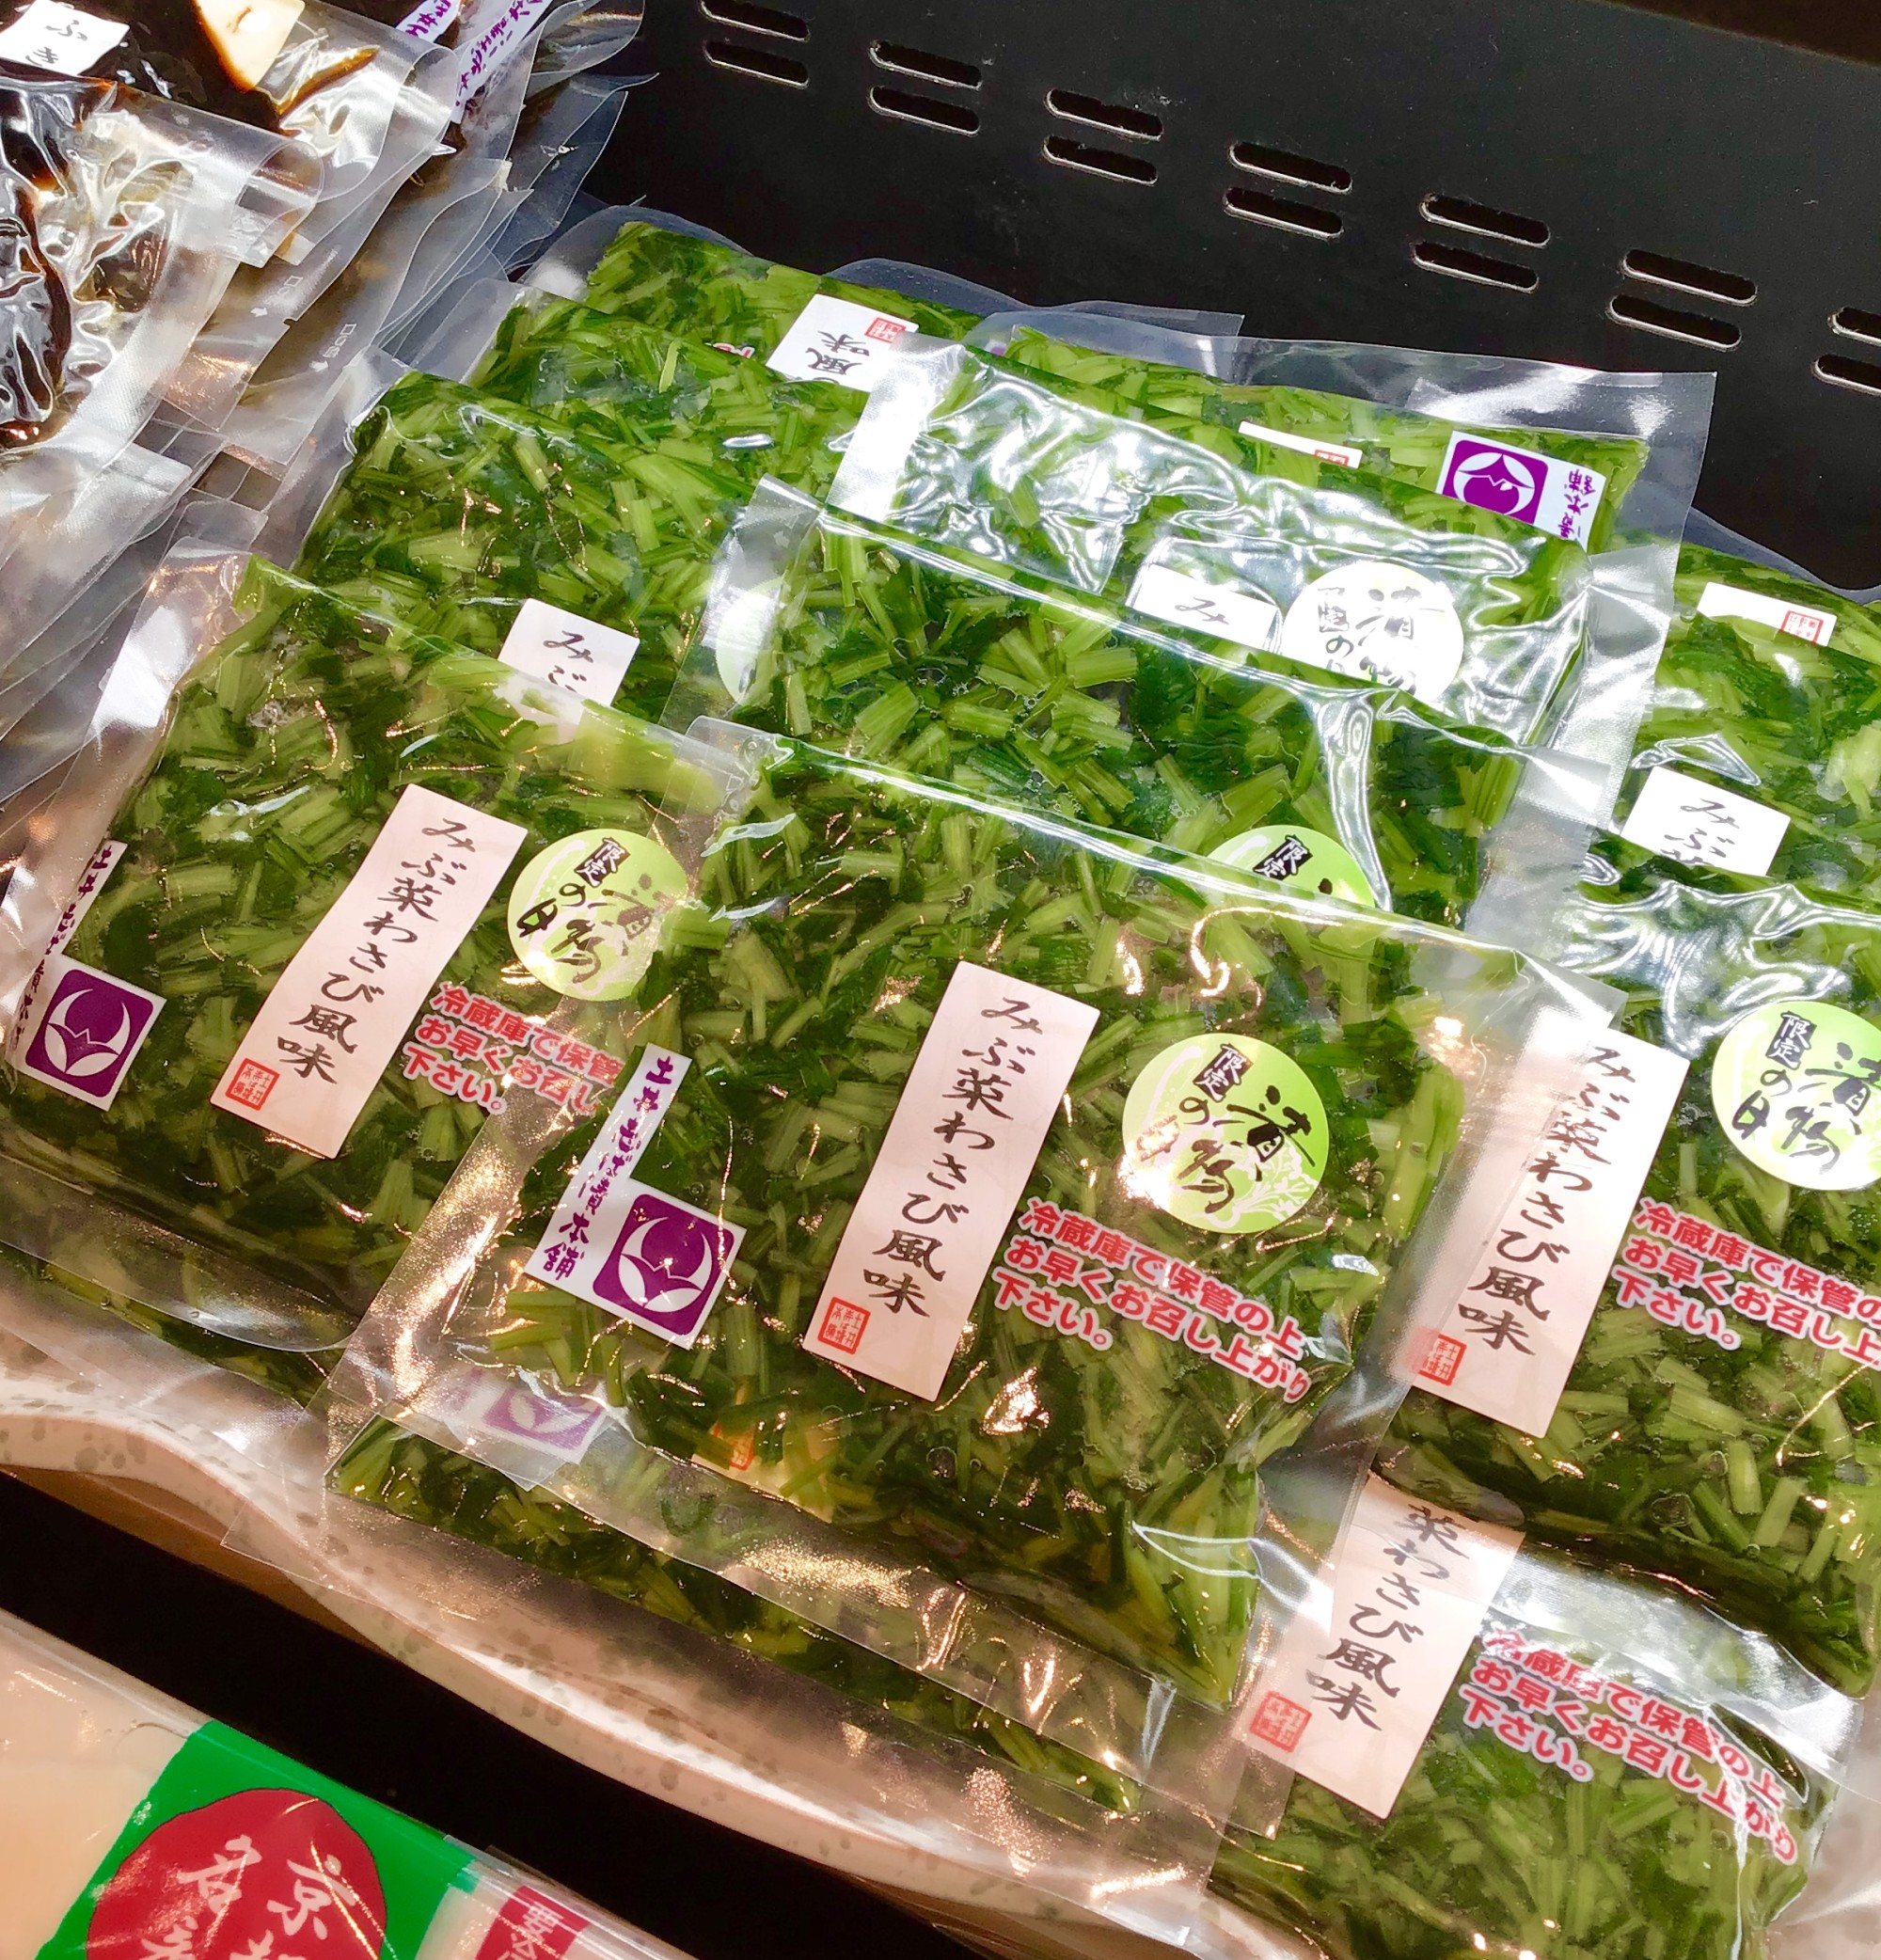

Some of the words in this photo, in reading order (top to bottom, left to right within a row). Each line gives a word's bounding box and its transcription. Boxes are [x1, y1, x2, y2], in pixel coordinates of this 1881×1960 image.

[24, 19, 88, 68] ふき
[805, 331, 870, 386] 風味
[1175, 595, 1230, 625] み
[574, 836, 632, 888] 限定
[277, 817, 476, 1085] みぶ菜わさび風味
[406, 1045, 502, 1111] 下さい。
[1193, 1042, 1255, 1102] 限定
[1765, 1009, 1818, 1071] 限定
[862, 996, 1044, 1318] みぶ菜わさび風味
[1458, 1046, 1637, 1356] みぶ菜わさび風味
[994, 1271, 1108, 1346] 下さい。
[1021, 1198, 1305, 1356] 冷蔵庫で保管の上
[1614, 1269, 1736, 1346] 下さい。
[1006, 1237, 1308, 1400] お早くお召し上がり
[1305, 1503, 1470, 1731] 菜わさび風味
[1462, 1687, 1589, 1778] 下さい。
